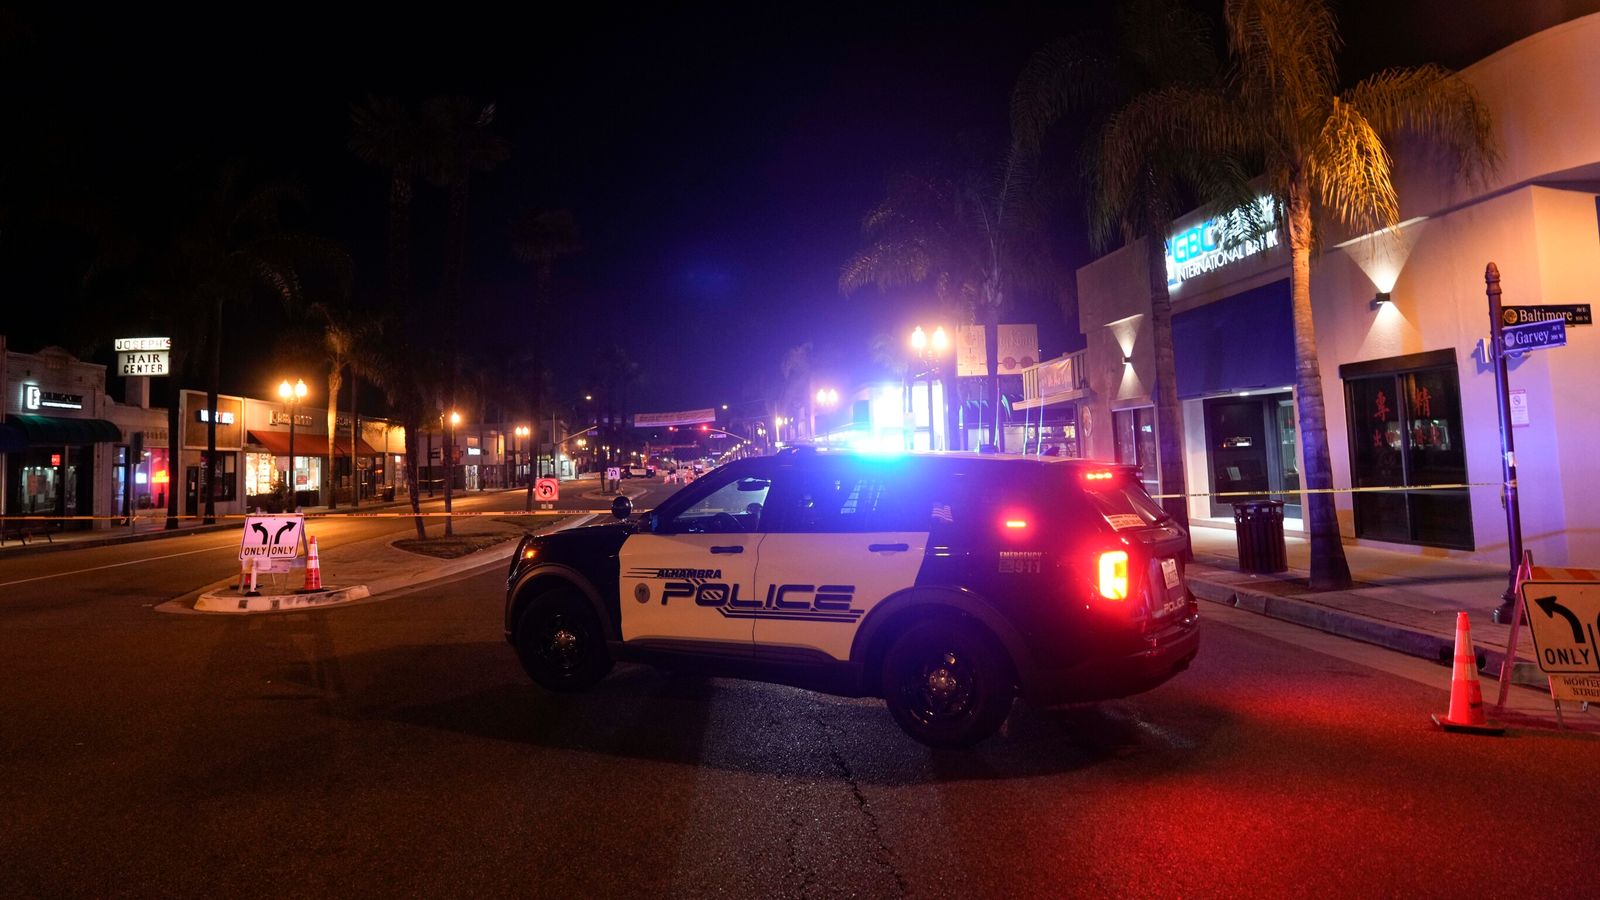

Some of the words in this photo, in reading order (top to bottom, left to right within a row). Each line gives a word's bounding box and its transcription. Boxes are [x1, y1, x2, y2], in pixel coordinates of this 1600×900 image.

[1173, 221, 1216, 263] GBC
[1179, 241, 1244, 282] INTERNATIONAL
[1520, 309, 1573, 322] Baltimore
[1515, 331, 1549, 344] Garvey
[116, 339, 171, 350] JOSEPH'S
[127, 354, 161, 364] HAIR
[123, 364, 163, 374] CENTER
[244, 547, 267, 556] ONLY
[271, 546, 294, 555] ONLY
[999, 551, 1042, 559] EMERGENCY
[657, 568, 722, 580] ALHAMBRA
[661, 582, 856, 611] POLICE
[1163, 596, 1185, 614] POLICE
[1545, 648, 1590, 665] ONLY
